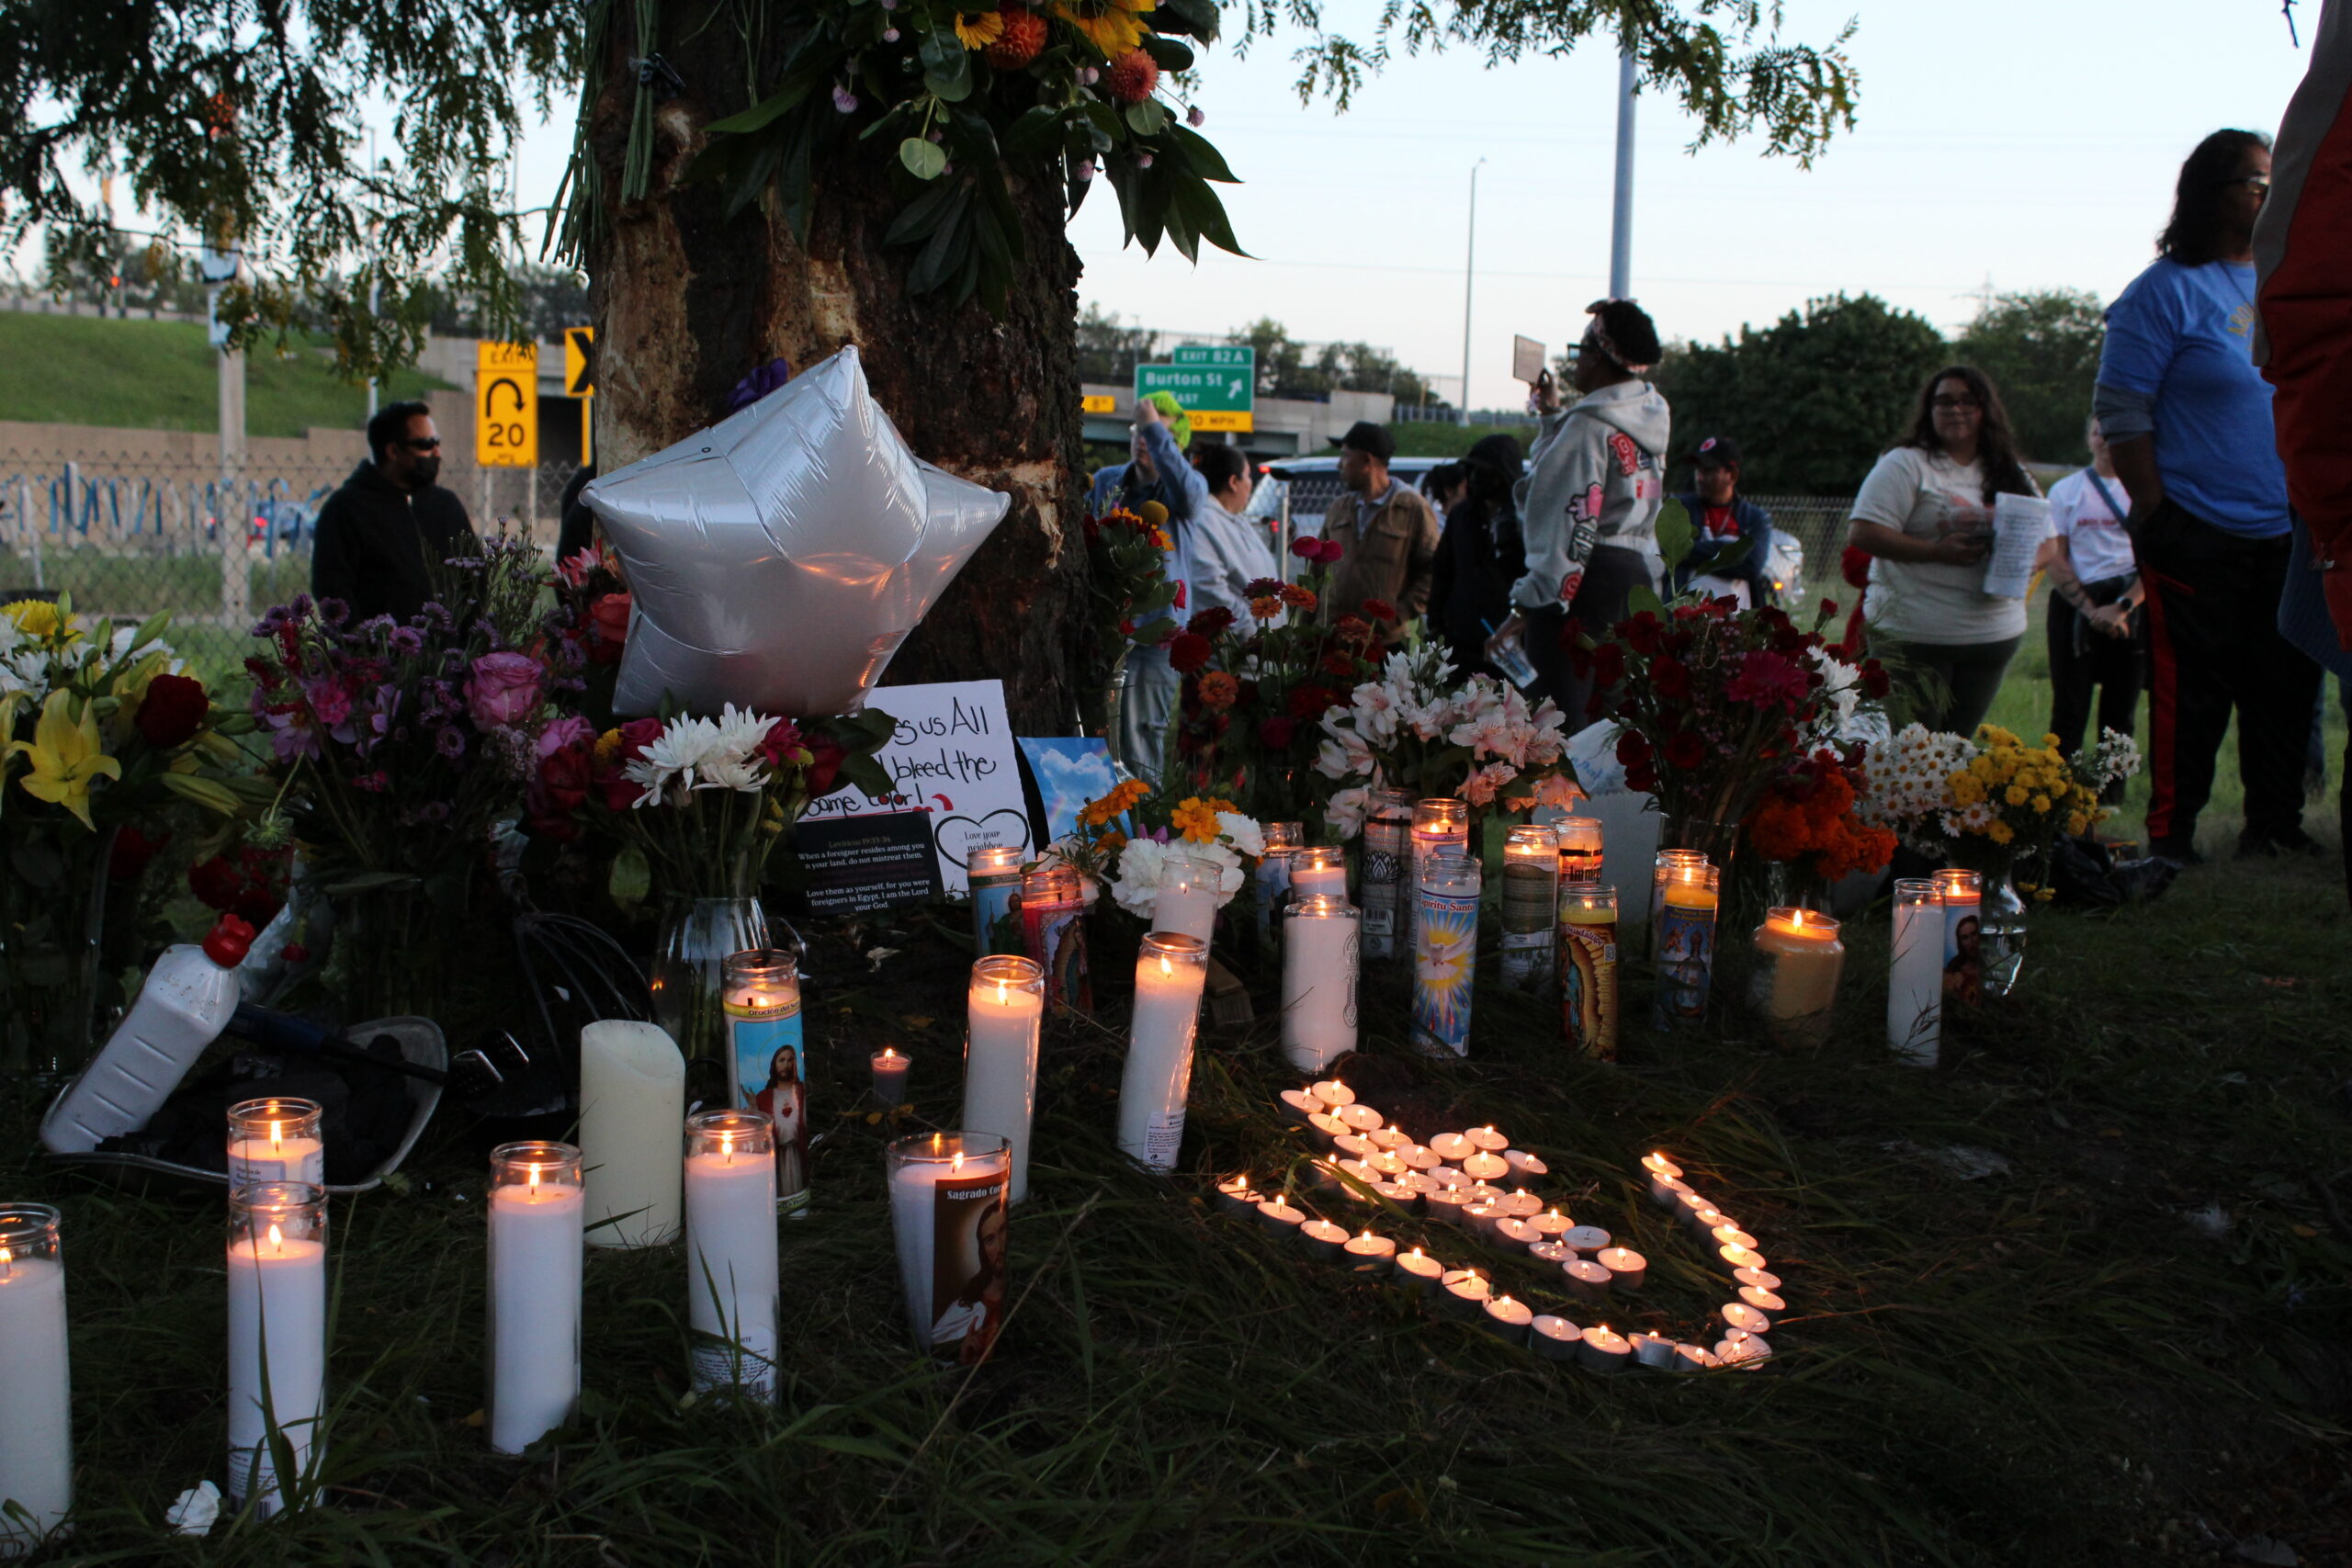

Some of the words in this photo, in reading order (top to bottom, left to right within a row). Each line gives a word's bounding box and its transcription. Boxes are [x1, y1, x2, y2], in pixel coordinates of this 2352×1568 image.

[1182, 351, 1207, 361] EXIT
[1146, 372, 1202, 386] Burton
[1206, 373, 1223, 386] St
[1210, 416, 1236, 425] MPH
[488, 423, 525, 446] 20
[951, 696, 989, 735] All
[892, 748, 955, 780] bleed
[953, 750, 996, 784] the
[964, 831, 981, 840] Love
[982, 830, 1001, 840] your
[797, 852, 820, 861] When
[827, 849, 859, 858] foreigner
[861, 846, 887, 854] resides
[887, 844, 910, 852] among
[811, 861, 829, 871] your
[859, 855, 872, 863] not
[872, 852, 902, 863] mistreat
[903, 852, 923, 860] them.
[807, 889, 824, 897] Love
[825, 886, 845, 896] them
[898, 882, 912, 890] you
[810, 897, 848, 908] foreigners
[898, 889, 910, 897] the
[910, 887, 930, 897] Lord
[854, 903, 872, 912] your
[1449, 902, 1475, 911] Santo
[1566, 924, 1602, 945] Guadalupe
[749, 1008, 779, 1016] Oración
[947, 1189, 988, 1201] Sagrado
